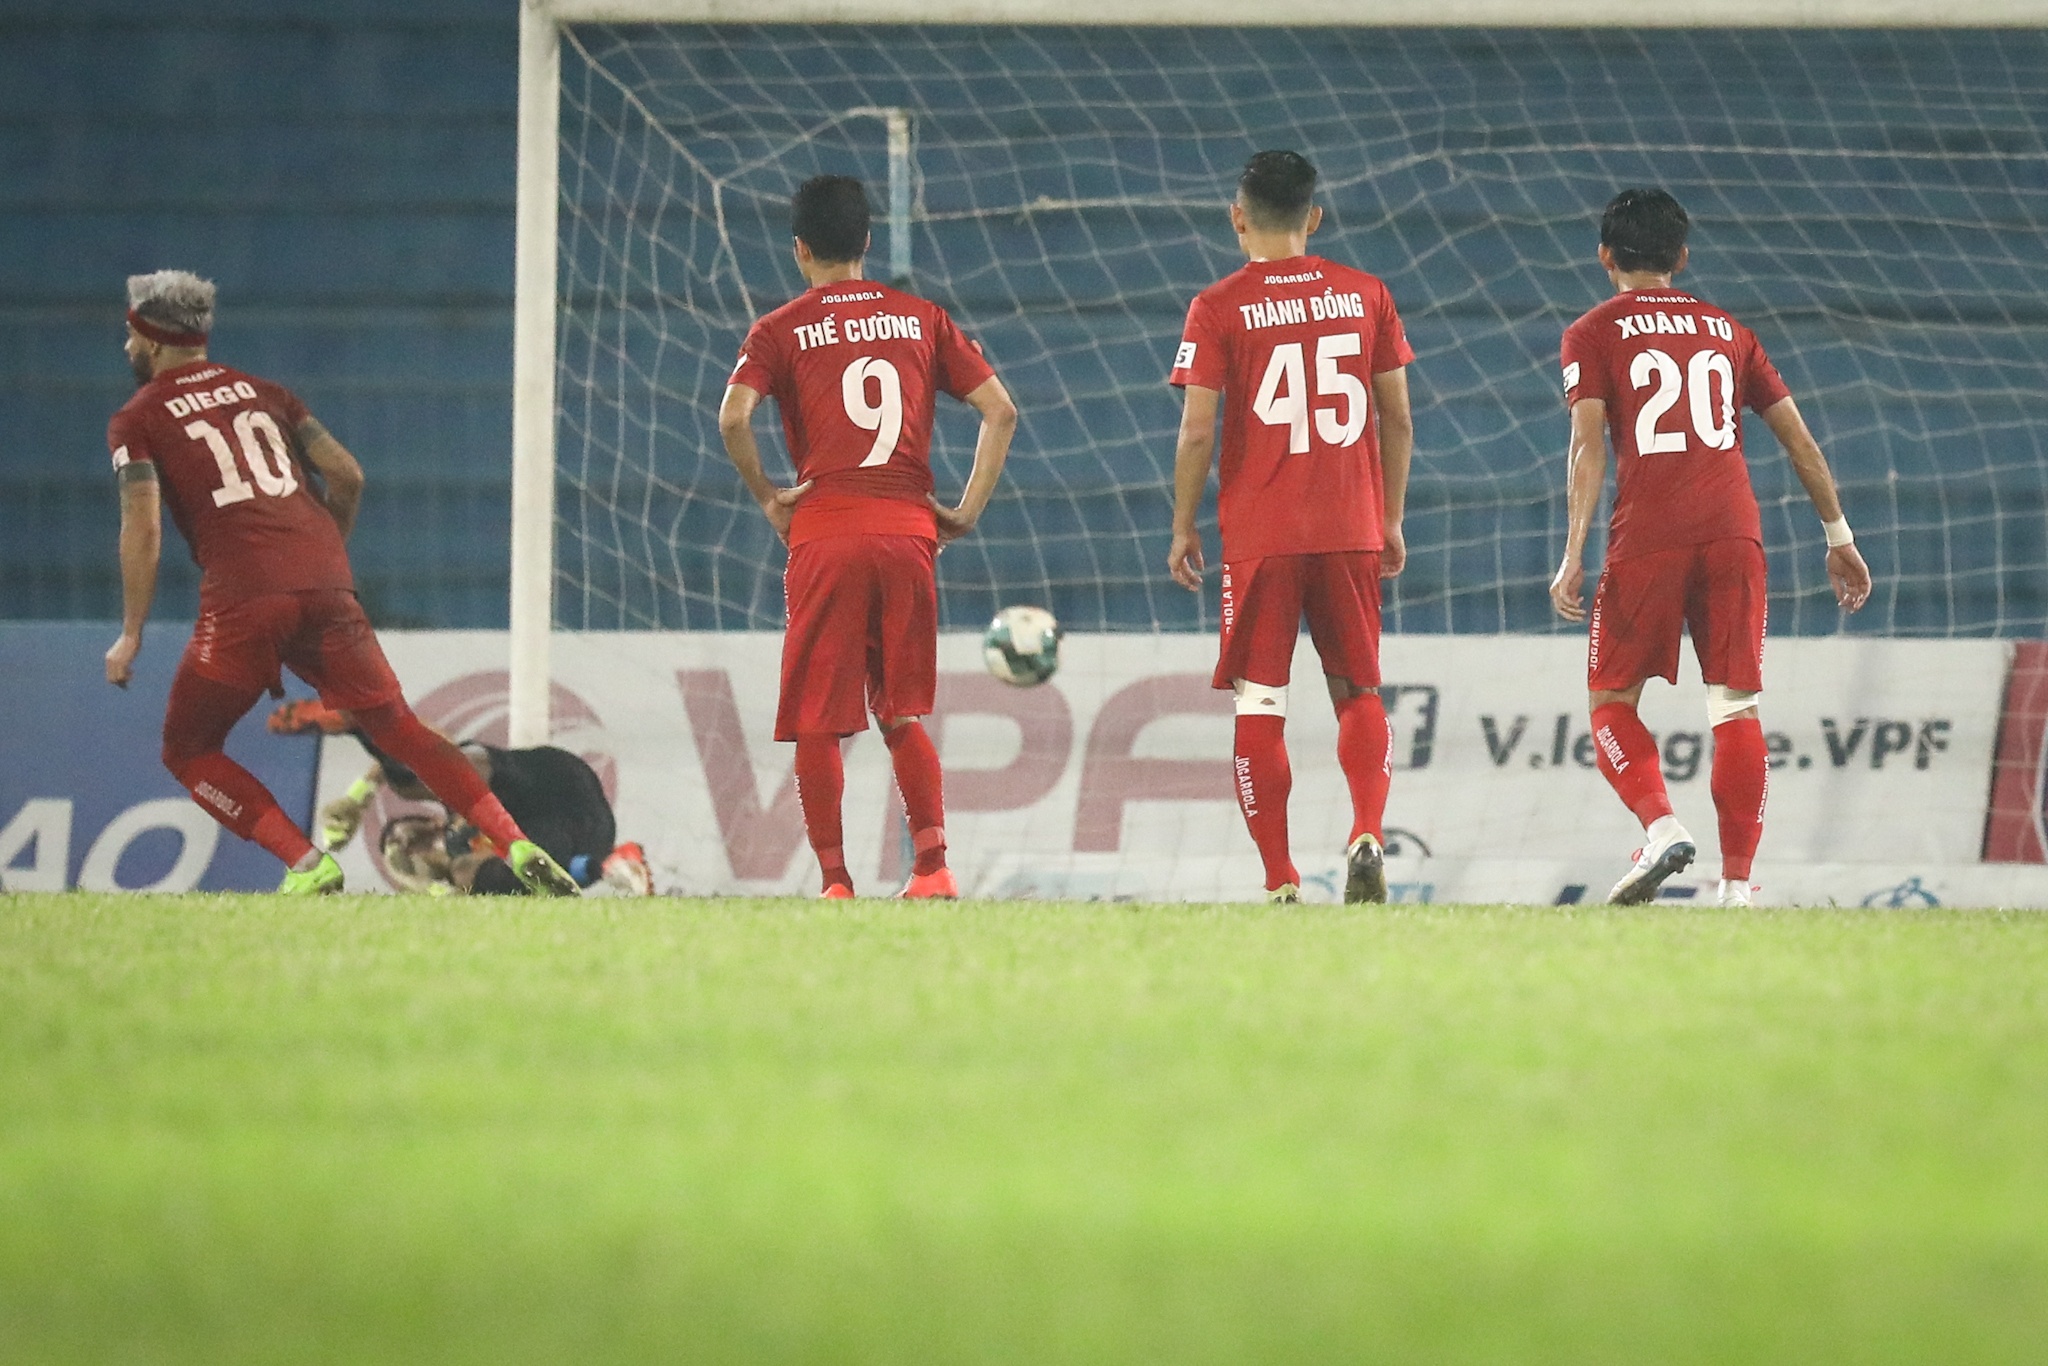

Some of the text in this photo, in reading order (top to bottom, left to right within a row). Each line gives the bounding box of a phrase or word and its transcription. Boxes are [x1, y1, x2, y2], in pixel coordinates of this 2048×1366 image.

[820, 291, 884, 304] JOGARBOLA
[1264, 270, 1323, 285] JOGARBOLA
[793, 311, 922, 351] THẾ CƯỜNG
[1239, 286, 1365, 331] THÀNH ĐỒNG
[1614, 311, 1698, 341] XUÂN
[164, 380, 258, 418] DIEGO
[841, 355, 904, 468] 9
[1252, 333, 1368, 455] 45
[1629, 348, 1737, 457] 20
[184, 409, 299, 508] 10
[1479, 714, 1951, 783] V.lege.VPF
[1595, 724, 1630, 775] JOGARBOLA
[1235, 755, 1258, 818] JOGARBOLA
